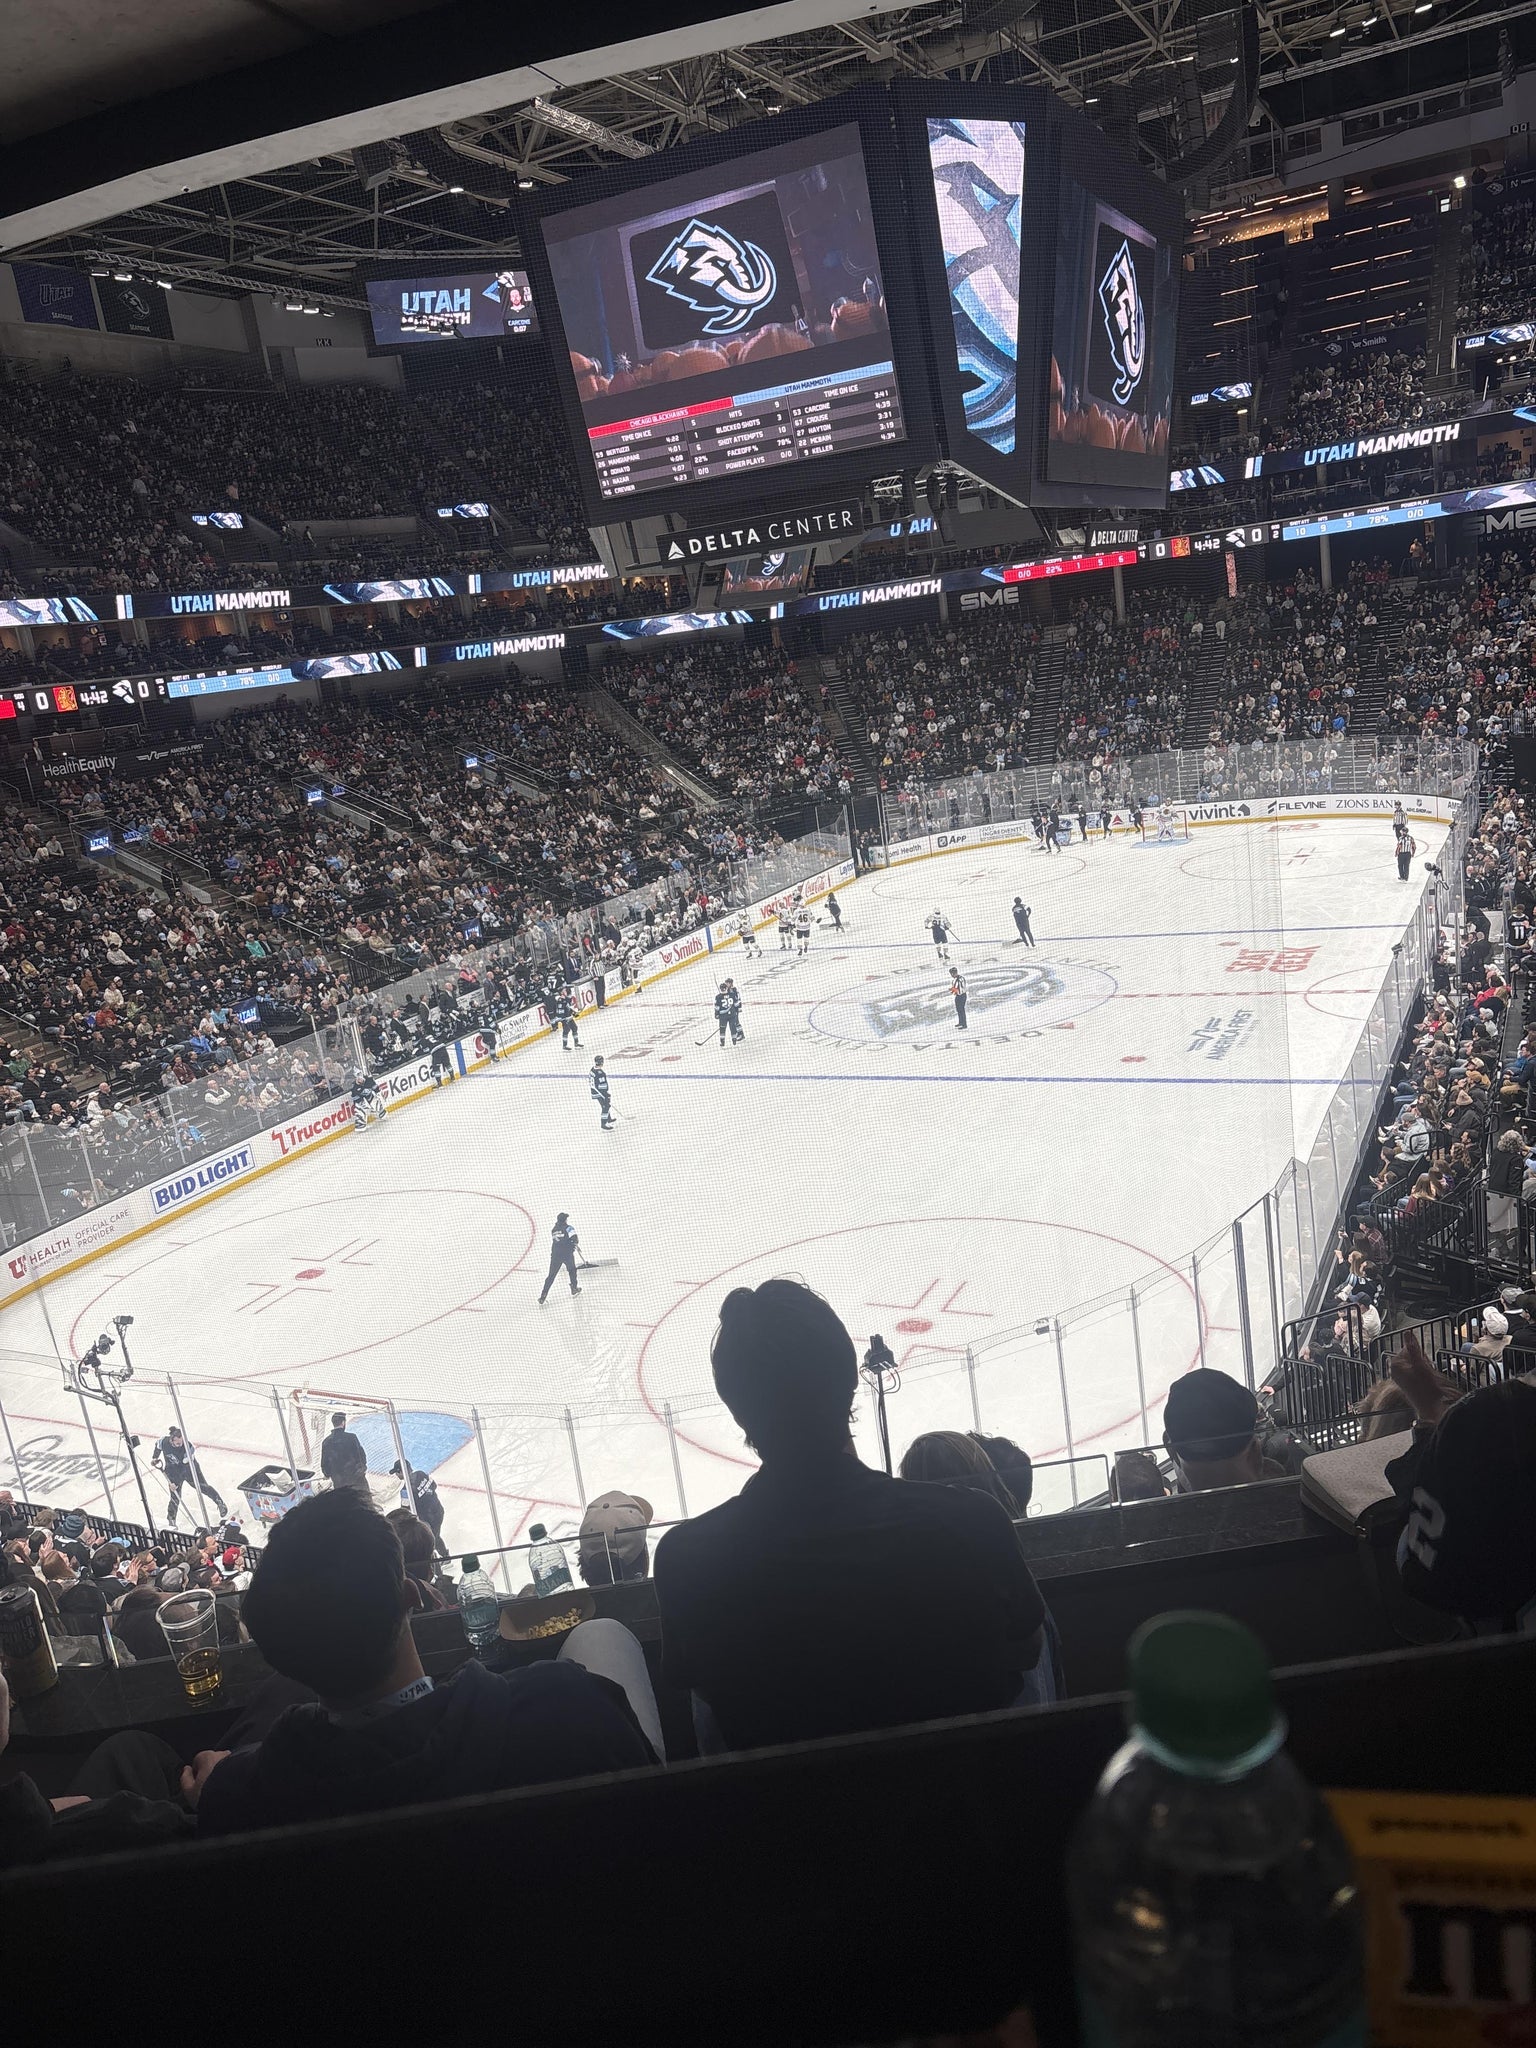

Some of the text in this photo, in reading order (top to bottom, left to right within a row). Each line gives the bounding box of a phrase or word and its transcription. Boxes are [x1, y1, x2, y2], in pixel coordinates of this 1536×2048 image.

[40, 284, 74, 307] UTAH
[402, 288, 471, 316] UTAH
[508, 319, 531, 327] CARCONE
[784, 377, 832, 393] UTAH MAMMOTH
[823, 384, 859, 398] TIME ON ICE
[728, 409, 743, 419] HITS
[793, 409, 802, 417] 53
[804, 402, 831, 414] CARCONE
[629, 409, 689, 428] CHICAGO BLACKHAWKS
[716, 423, 741, 434] BLOCKED
[741, 418, 761, 428] SHOTS
[806, 414, 829, 424] CROUSE
[621, 429, 652, 442] TIME ON ICE
[808, 423, 832, 434] HAYTON
[717, 437, 733, 446] SHOT
[733, 430, 764, 443] ATTEMPTS
[1304, 423, 1460, 467] UTAH MAMMOTH
[694, 455, 709, 463] 22%
[727, 446, 753, 457] FACEOFF
[811, 444, 834, 455] KELLER
[697, 450, 793, 475] 0/0 POWER PLAYS 0/0
[890, 517, 933, 537] UAH
[1295, 527, 1307, 536] 10
[1369, 514, 1389, 524] 78%
[1407, 509, 1424, 519] 0/0
[688, 510, 853, 555] DELTA CENTER
[1097, 528, 1140, 545] DELTA CENTER
[1251, 528, 1262, 542] 0
[1155, 543, 1166, 556] 0
[1194, 538, 1220, 551] 4:42
[513, 564, 608, 588] UTAH MAMMO
[1018, 569, 1031, 579] 0/0
[1045, 565, 1062, 574] 22%
[171, 590, 290, 614] UTAH MAMMOTH
[819, 579, 942, 611] UTAH MAMMOTH
[960, 586, 1020, 611] SME
[455, 633, 565, 661] UTAH MAMMOTH
[137, 681, 150, 698] 0
[179, 684, 189, 693] 10
[17, 700, 26, 711] 4
[35, 692, 49, 710] 0
[80, 690, 109, 706] 4:42
[170, 745, 191, 754] AMERICA
[191, 743, 204, 751] FIRST
[42, 755, 117, 777] HealthEquity
[1189, 804, 1236, 821] vivint
[1278, 801, 1326, 810] FILEVINE
[1336, 799, 1370, 809] ZIONS
[90, 836, 109, 848] UTAH
[900, 843, 922, 855] Health
[799, 914, 808, 923] 46
[1514, 926, 1525, 940] 11
[673, 937, 703, 961] Smith's
[509, 1014, 530, 1029] SWAPP
[388, 1073, 418, 1097] Ken
[155, 1149, 250, 1209] BUD LIGHT
[75, 1209, 130, 1240] OFFICIAL CARE
[78, 1225, 115, 1247] PROVIDER
[29, 1237, 71, 1265] HEALTH
[1407, 1486, 1447, 1571] 2
[400, 1680, 430, 1703] UTAH
